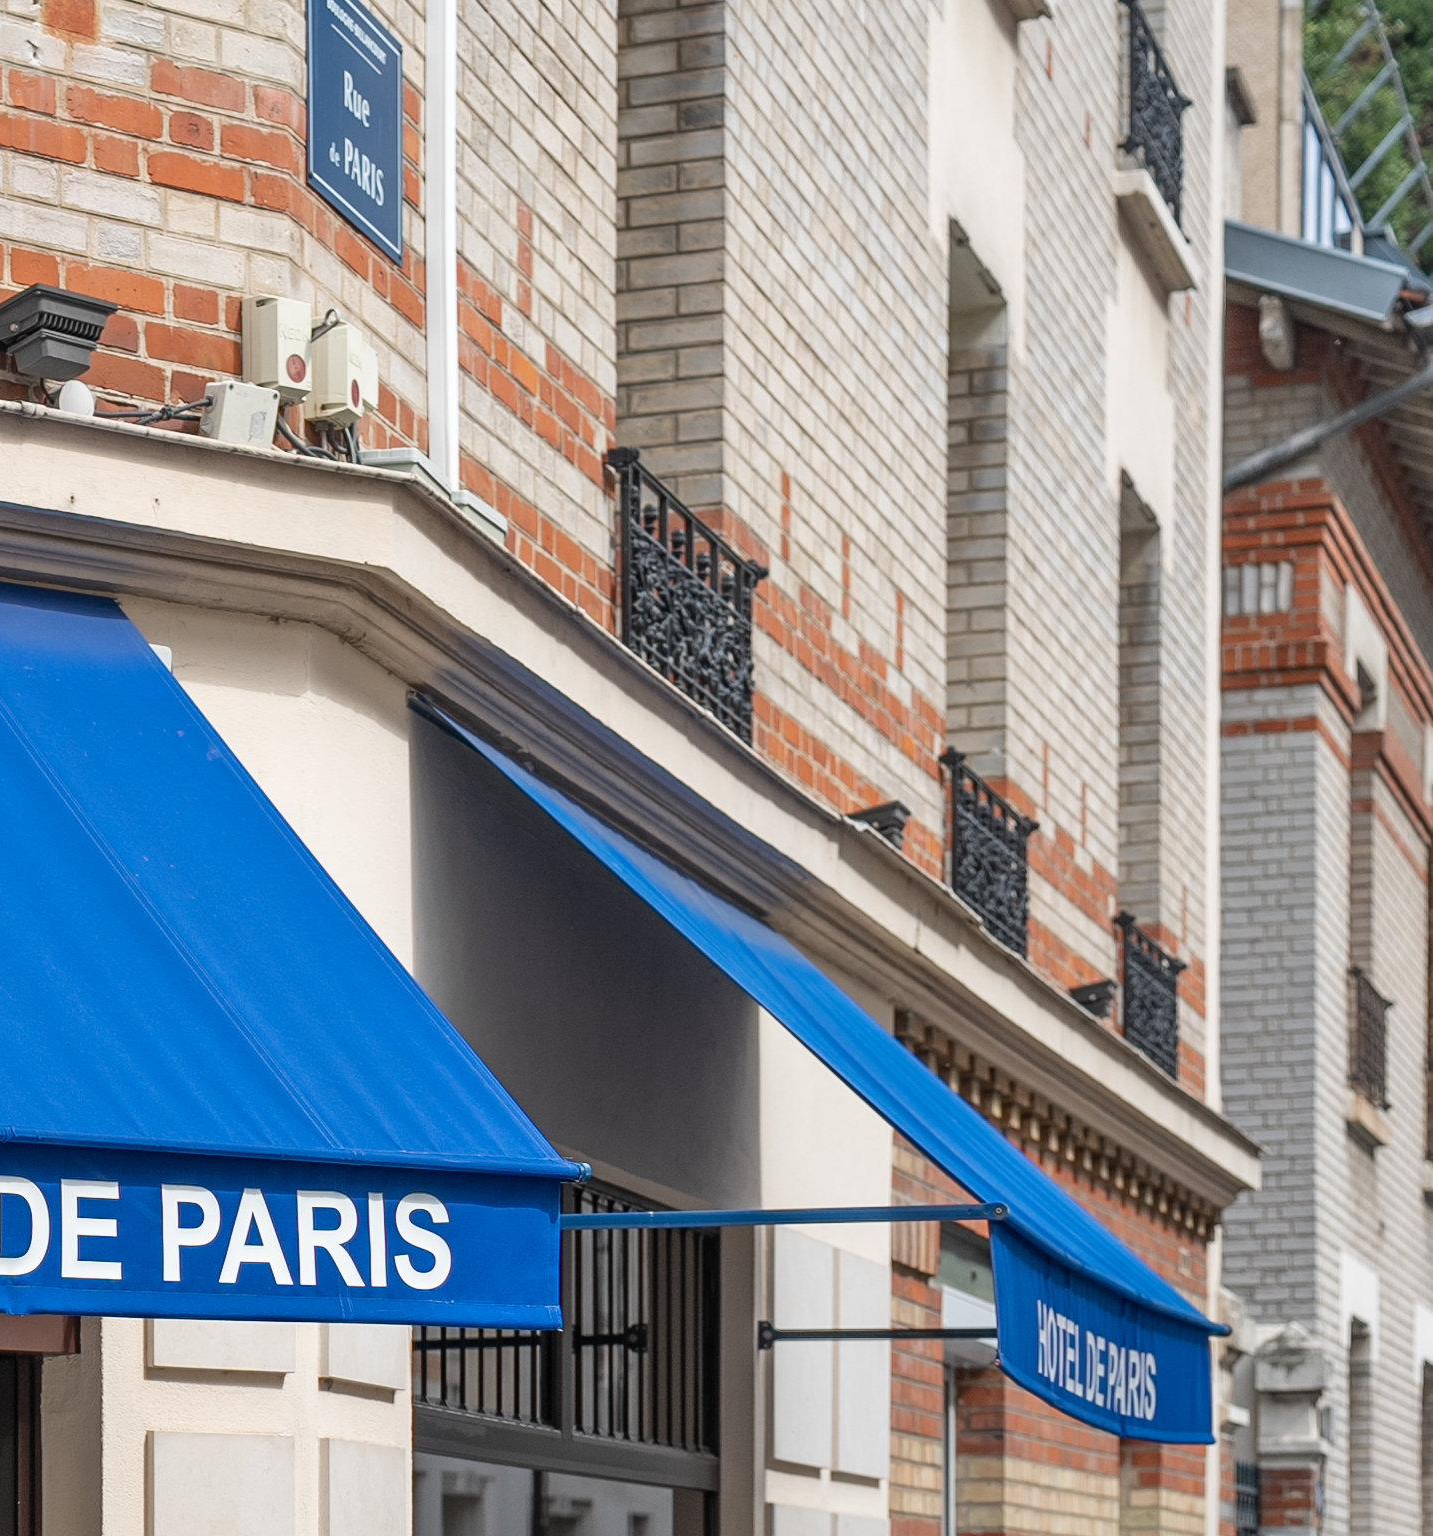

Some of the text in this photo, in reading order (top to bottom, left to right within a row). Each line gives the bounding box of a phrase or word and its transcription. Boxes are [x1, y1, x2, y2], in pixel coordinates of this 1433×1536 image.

[343, 69, 371, 128] Rue
[328, 137, 385, 207] de PARIS
[162, 1183, 453, 1290] PARIS
[1037, 1299, 1157, 1421] HOTEL DE PARIS
